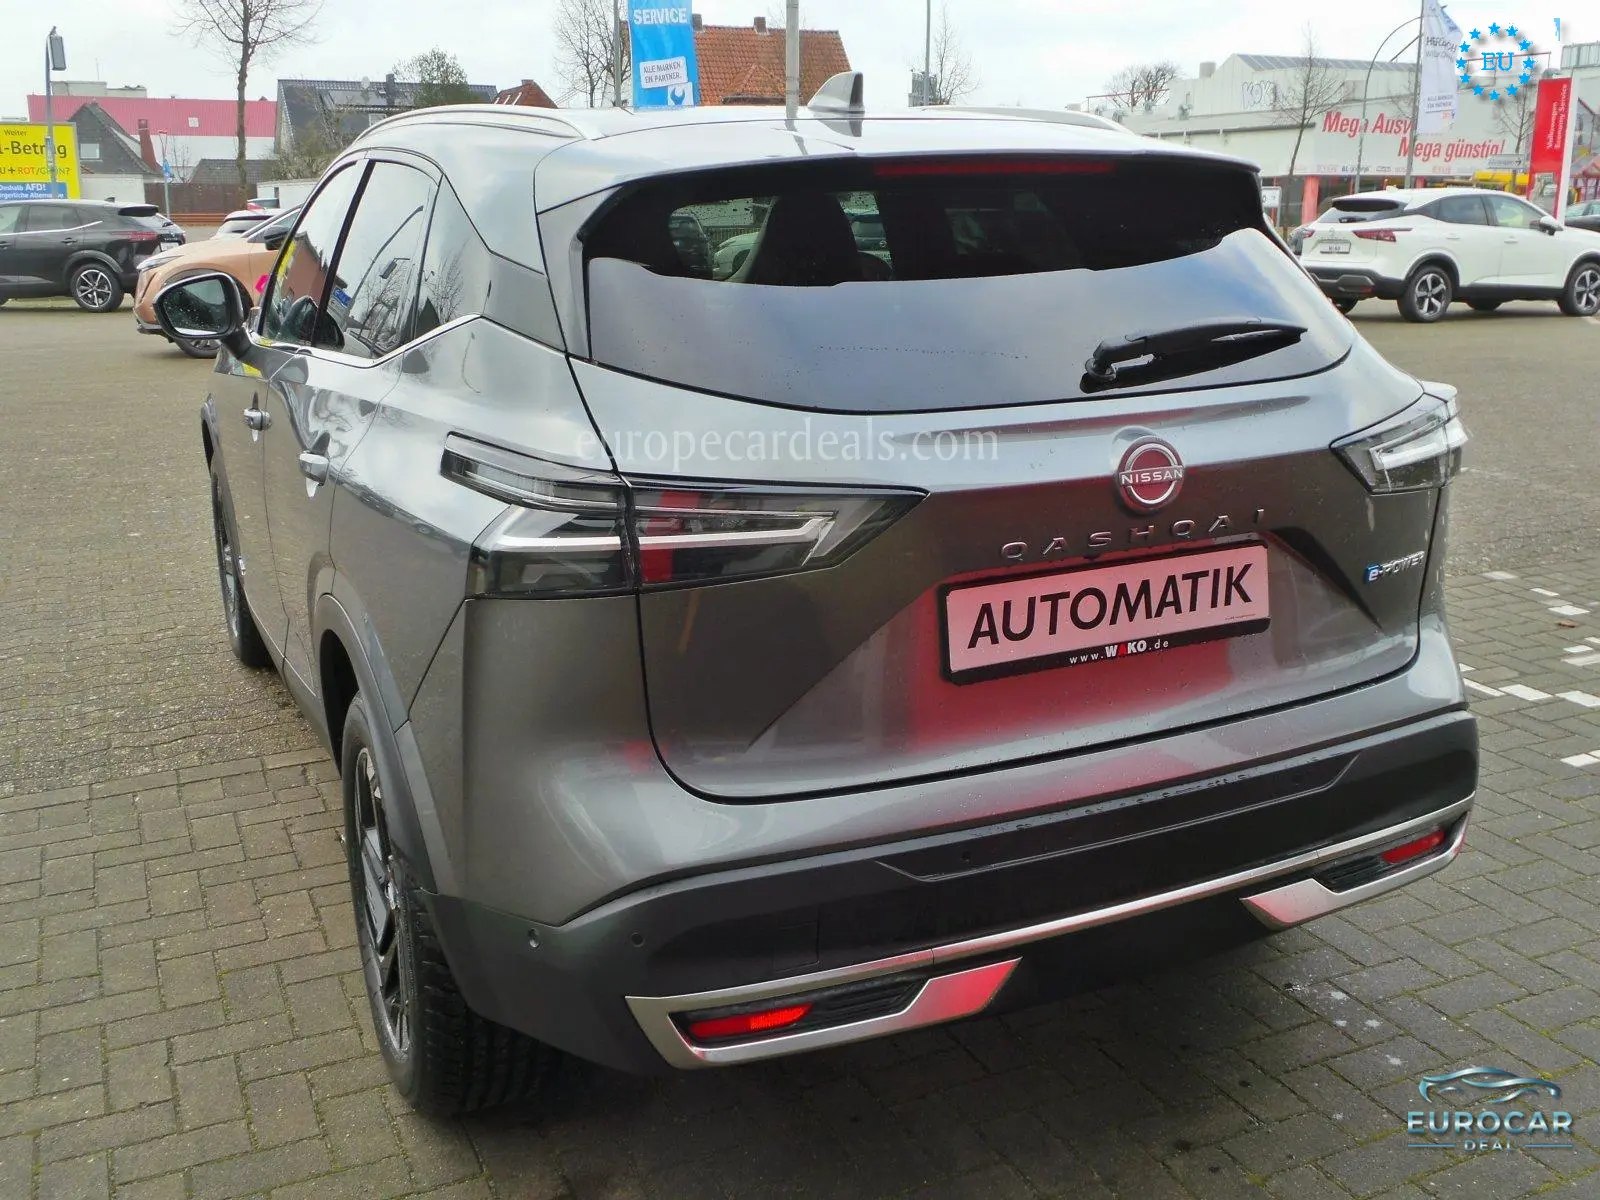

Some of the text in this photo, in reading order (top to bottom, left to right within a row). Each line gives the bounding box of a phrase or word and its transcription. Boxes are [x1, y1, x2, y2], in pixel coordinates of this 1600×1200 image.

[633, 8, 687, 24] SERVICE
[1322, 111, 1369, 138] Mega
[1398, 137, 1441, 162] Mega
[25, 183, 46, 191] AFD!
[1121, 466, 1184, 484] NISSAN
[1001, 508, 1265, 561] QASHQAI
[967, 563, 1253, 649] AUTOMATIK
